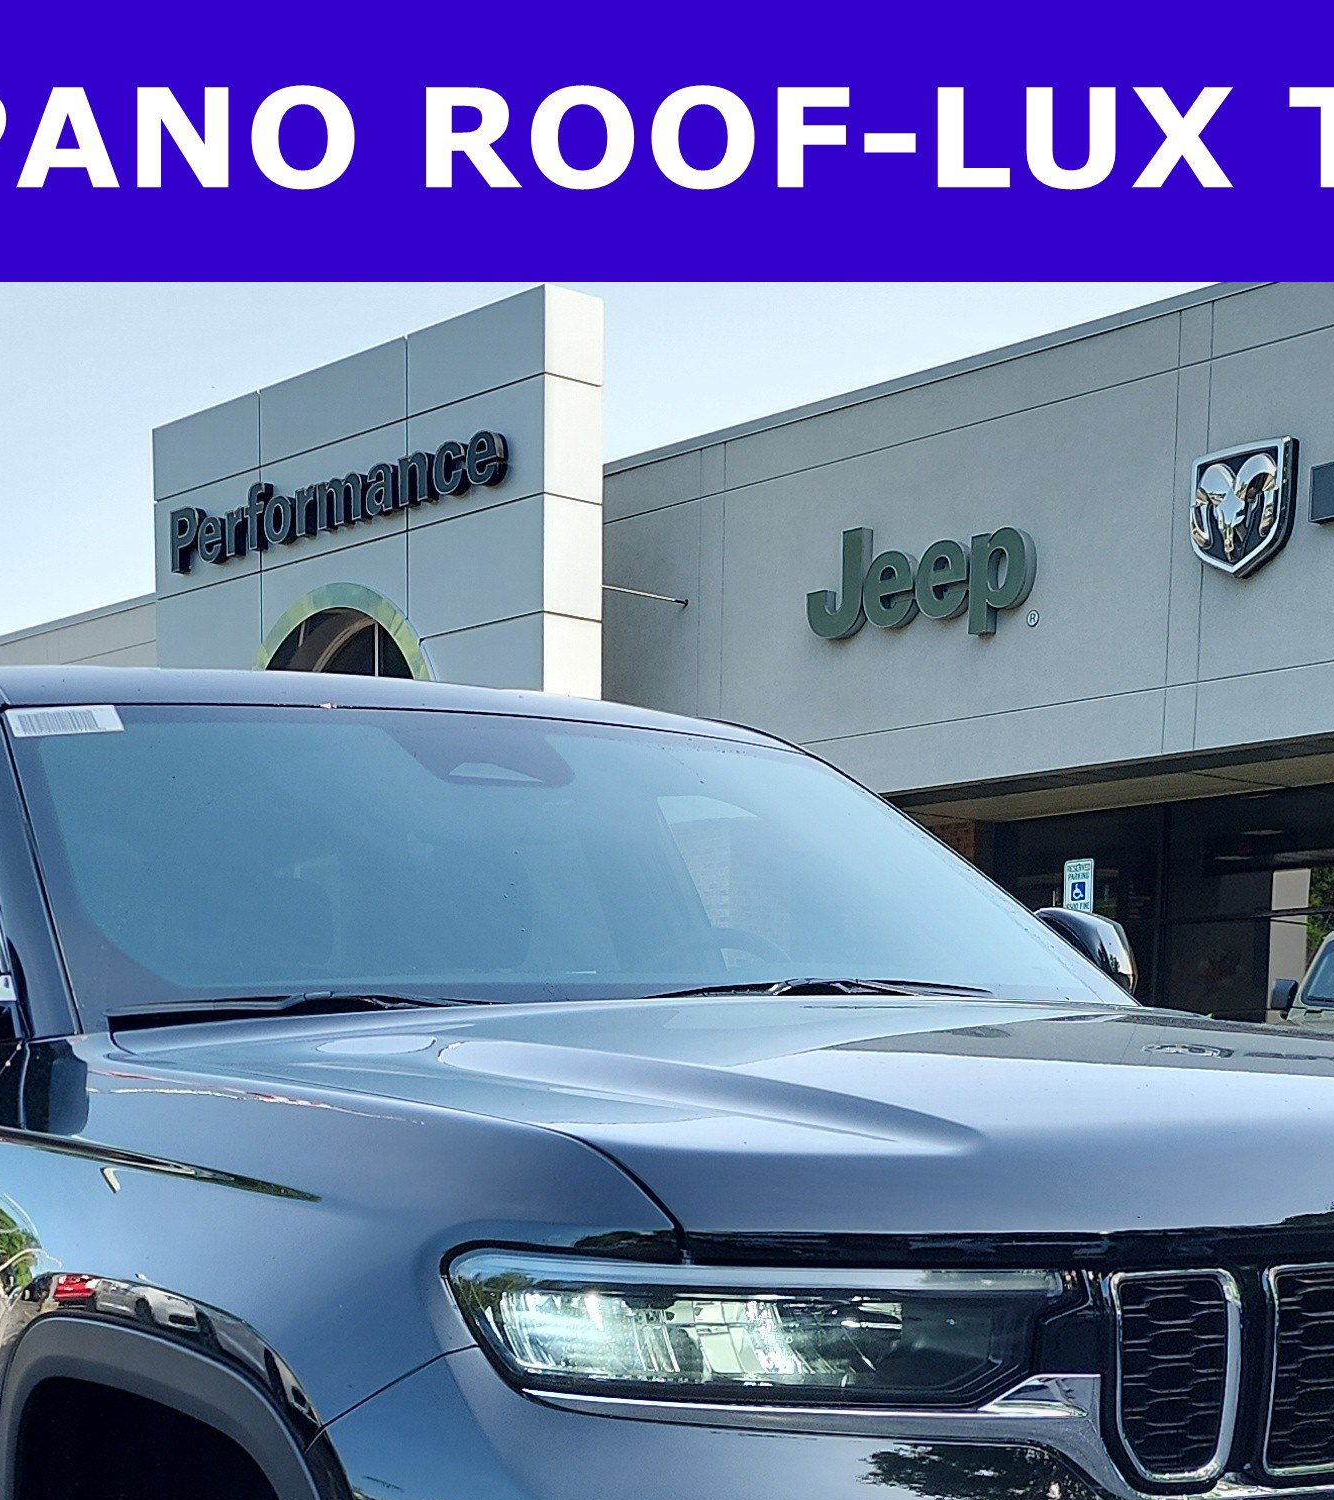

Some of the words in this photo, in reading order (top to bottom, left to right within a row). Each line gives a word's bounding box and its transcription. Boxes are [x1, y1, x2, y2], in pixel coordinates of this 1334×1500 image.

[169, 429, 509, 574] Performance
[806, 526, 1037, 637] Jeep
[1068, 872, 1090, 881] PARKING
